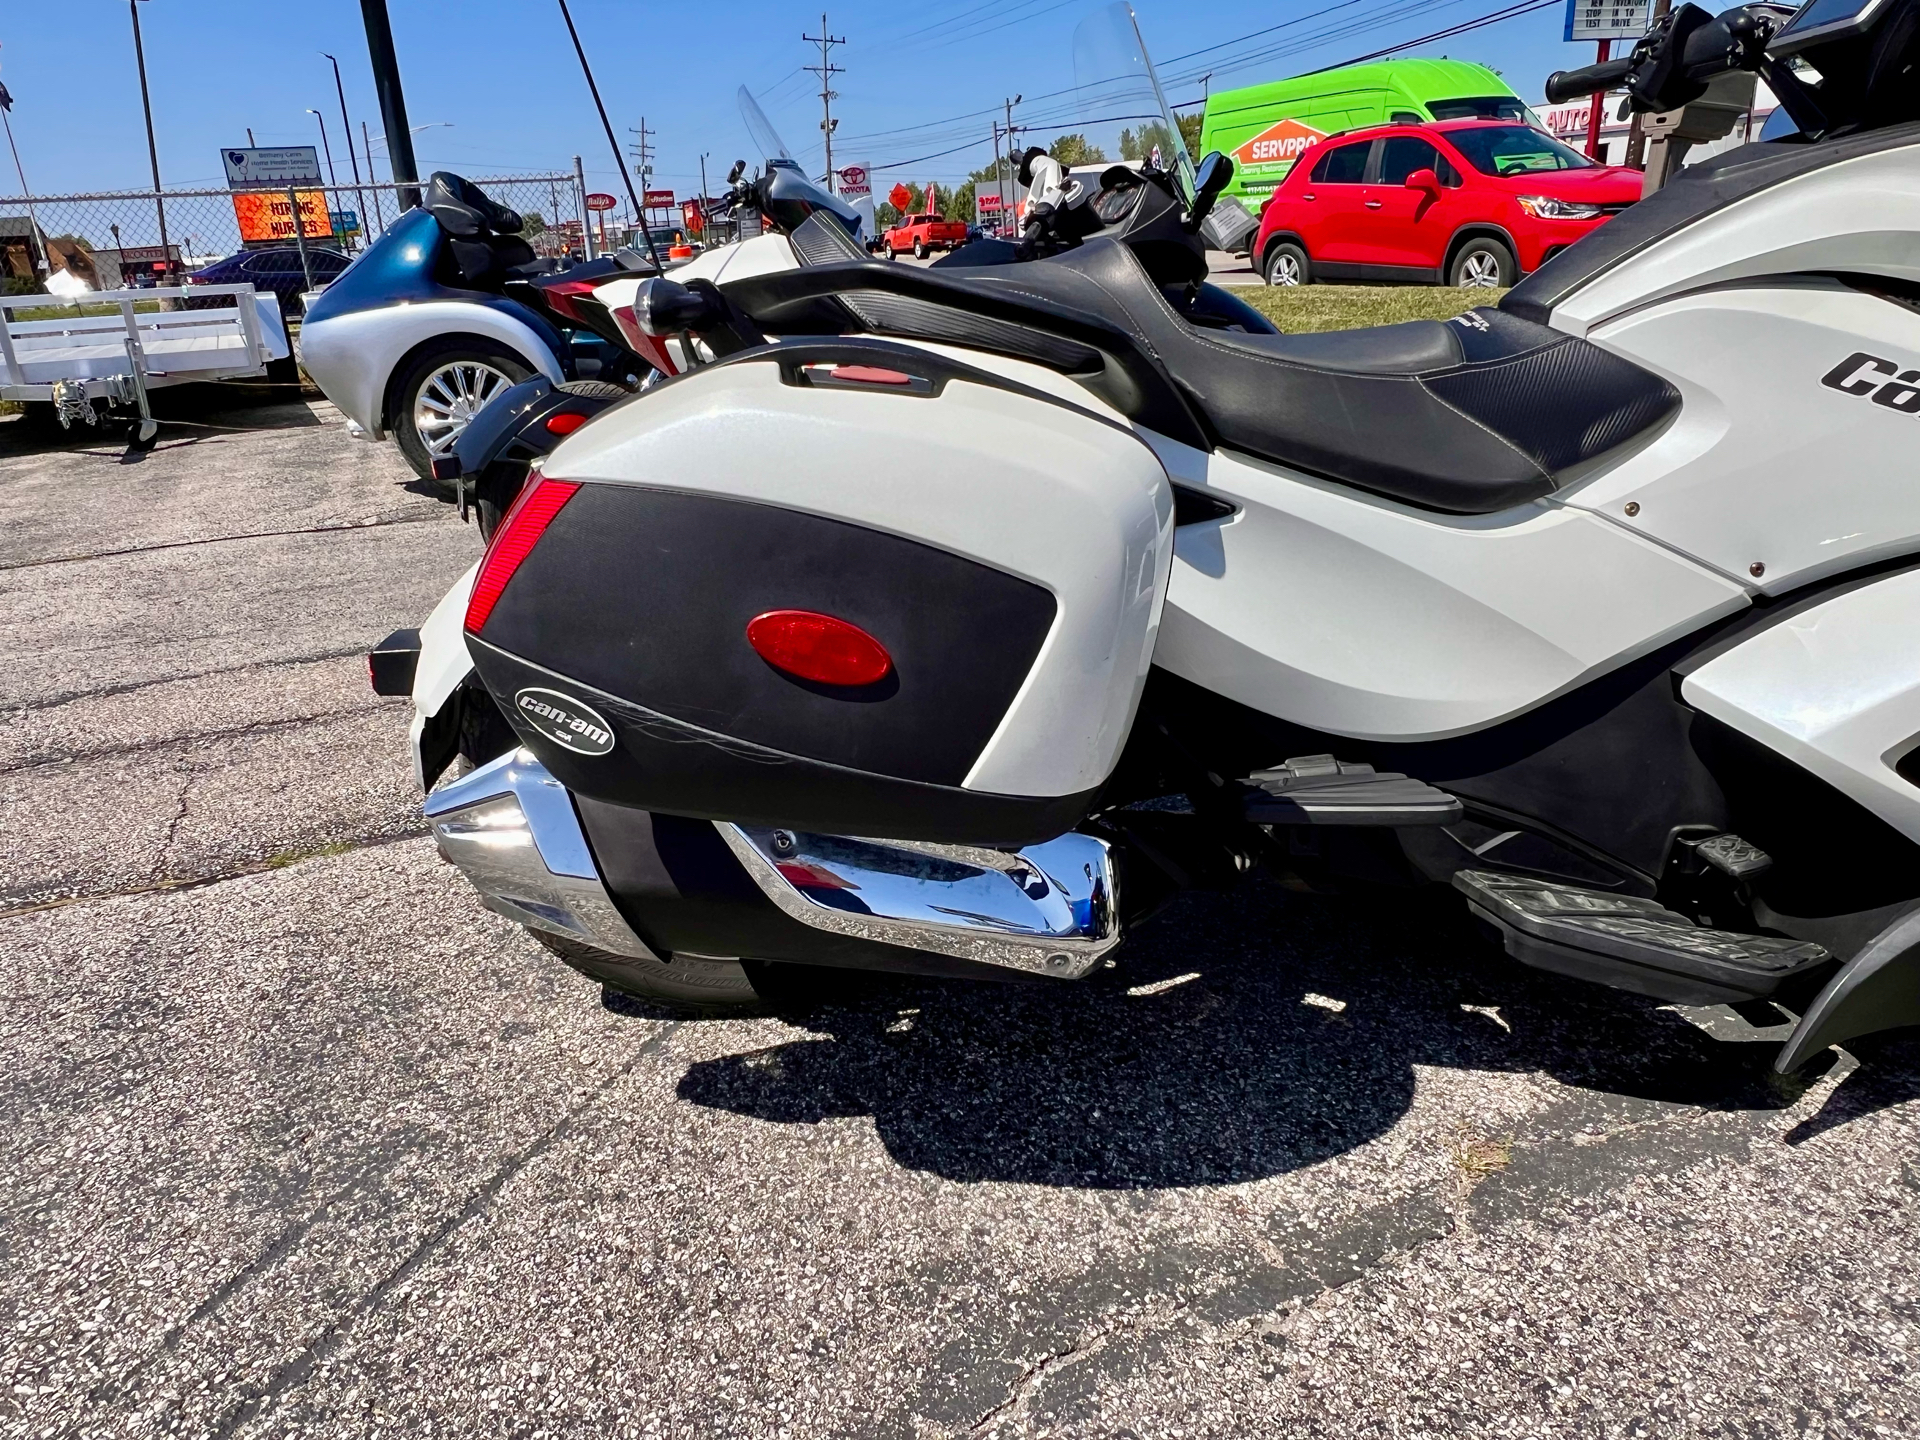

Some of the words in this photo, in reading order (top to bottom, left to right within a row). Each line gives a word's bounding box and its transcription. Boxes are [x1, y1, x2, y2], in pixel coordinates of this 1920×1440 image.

[1586, 9, 1602, 18] STOP
[1612, 9, 1619, 17] IN
[1625, 9, 1635, 17] TO
[1586, 19, 1601, 28] TEST
[1611, 19, 1631, 27] DRIVE
[1546, 106, 1609, 133] AUTO
[1252, 135, 1318, 159] SERVPRO
[839, 186, 871, 194] TOYOTA
[270, 201, 315, 216] HIRNG
[270, 220, 317, 235] NURES
[1820, 351, 1920, 417] Ca
[519, 695, 610, 745] can-am
